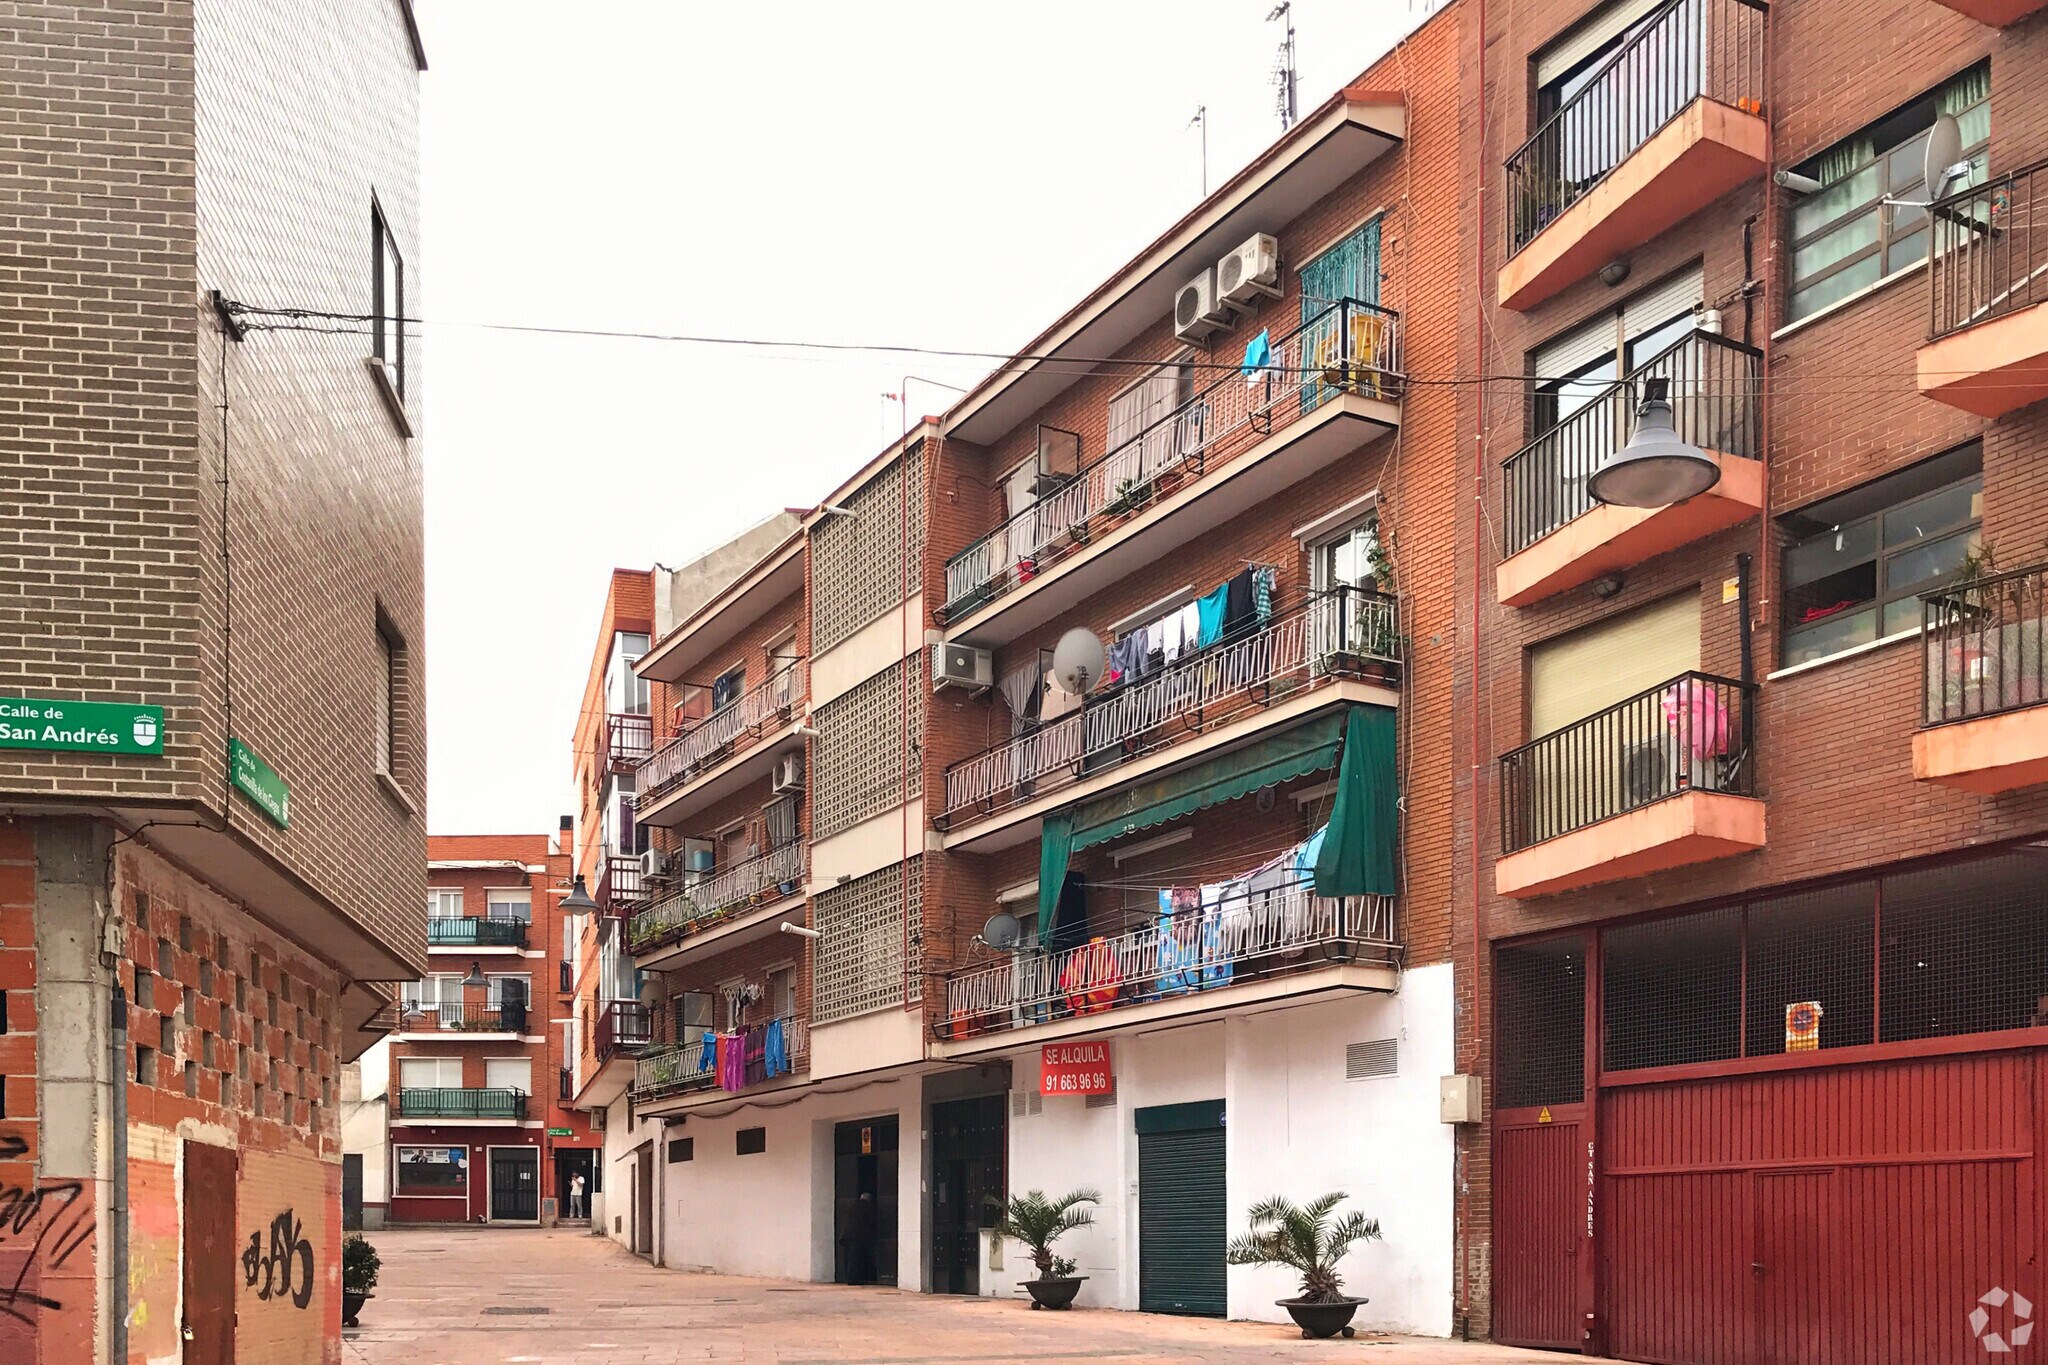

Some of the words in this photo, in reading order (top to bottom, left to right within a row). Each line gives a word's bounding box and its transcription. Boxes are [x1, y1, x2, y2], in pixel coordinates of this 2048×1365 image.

[0, 705, 39, 718] Calle
[44, 707, 64, 720] de
[0, 723, 36, 740] San
[41, 725, 119, 745] Andrés
[239, 749, 250, 766] Calle
[1046, 1048, 1059, 1065] SE
[1061, 1045, 1105, 1064] ALQUILA
[1046, 1075, 1058, 1091] 91
[1060, 1074, 1077, 1091] 663
[1079, 1073, 1091, 1090] 96
[1093, 1072, 1106, 1089] 96
